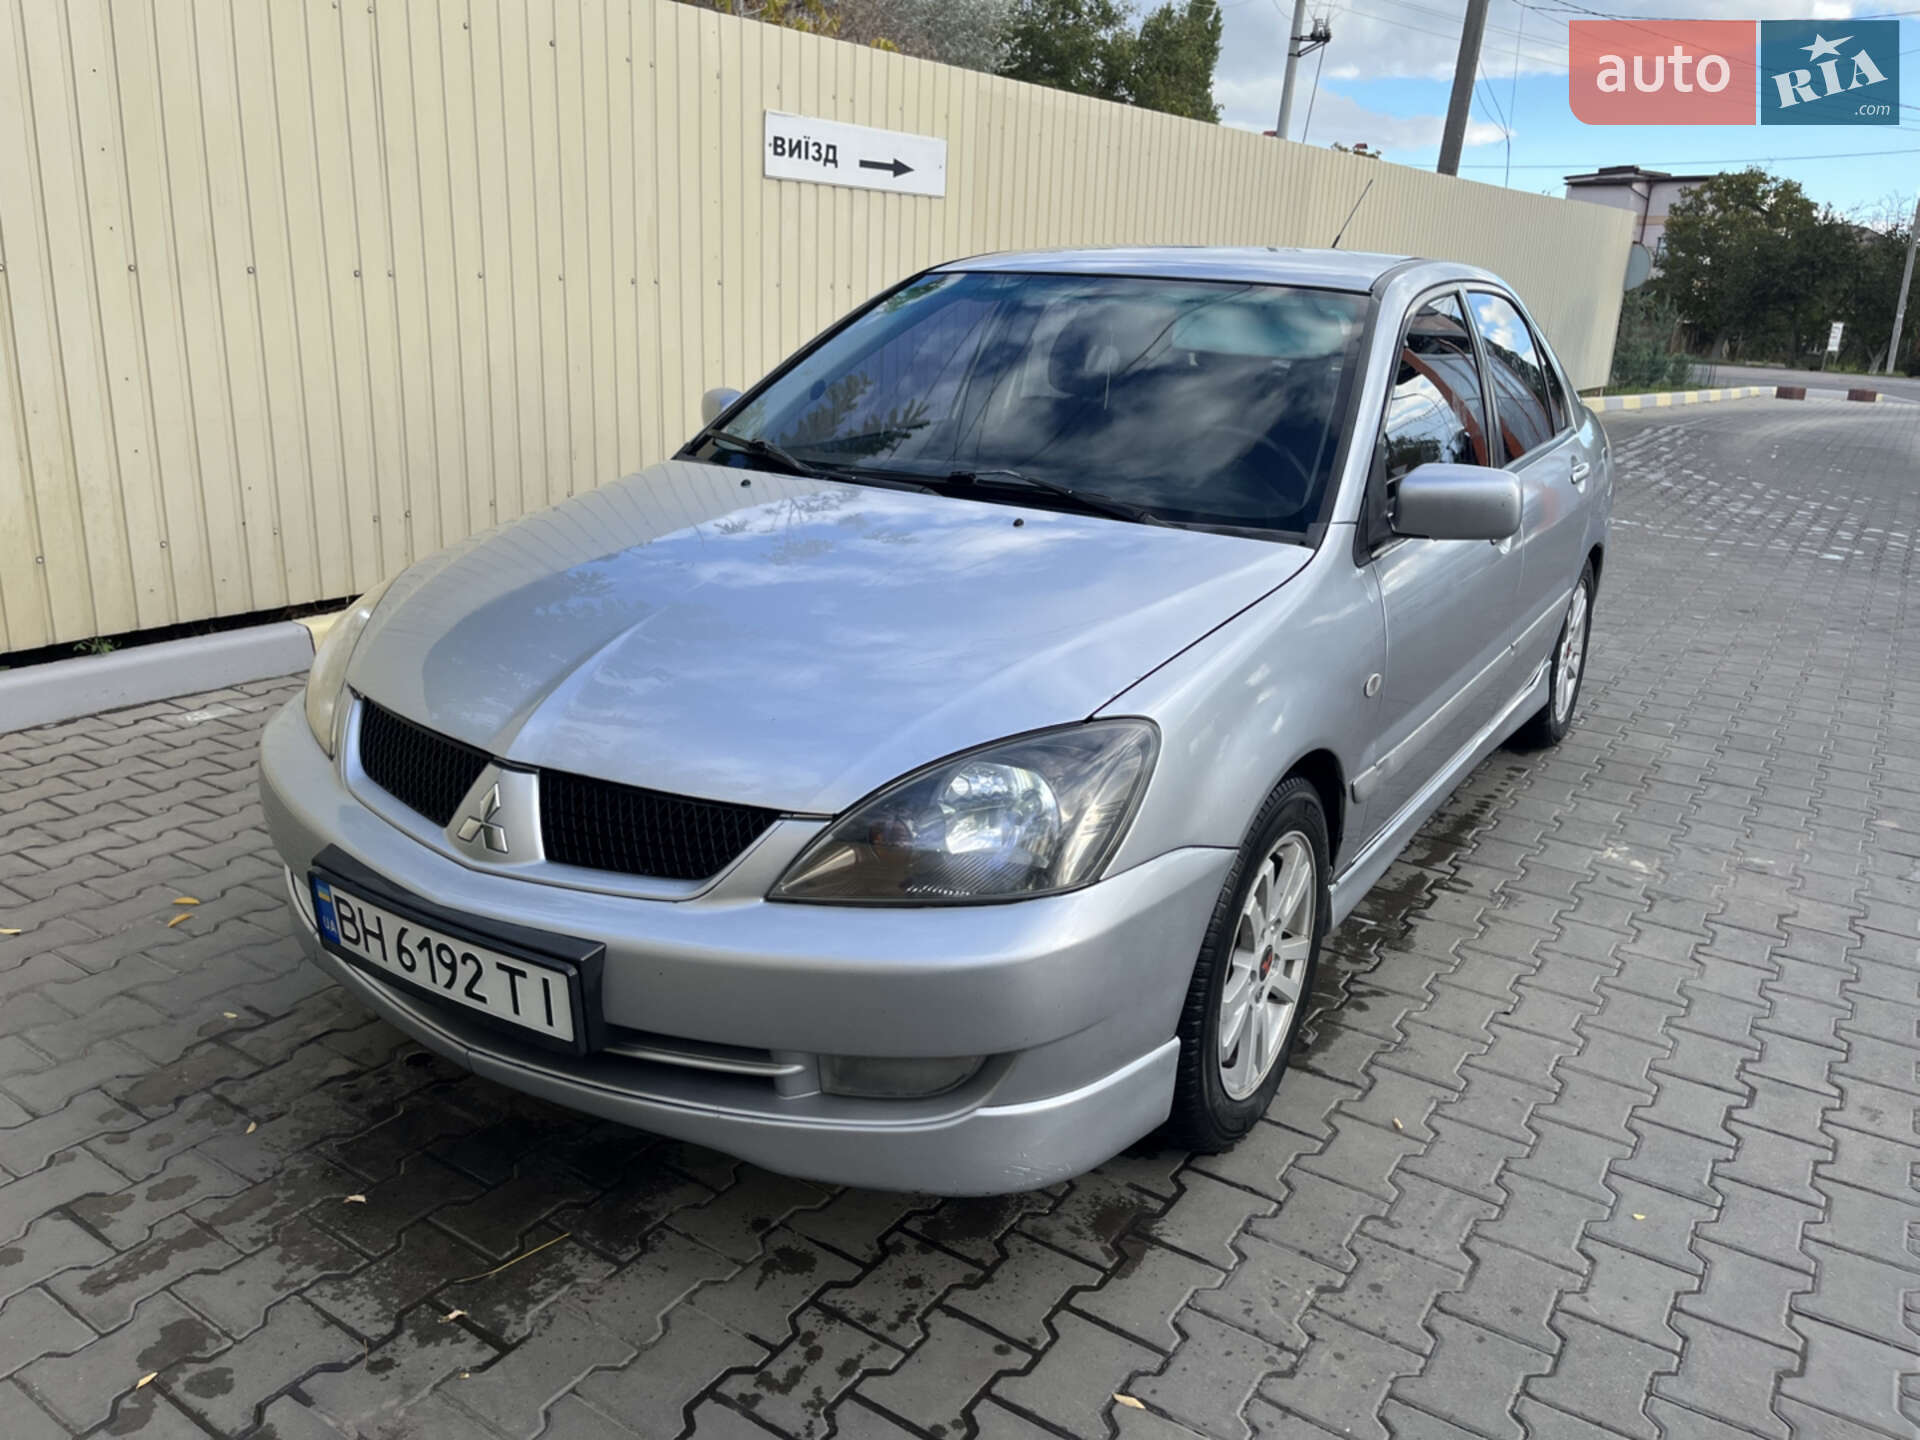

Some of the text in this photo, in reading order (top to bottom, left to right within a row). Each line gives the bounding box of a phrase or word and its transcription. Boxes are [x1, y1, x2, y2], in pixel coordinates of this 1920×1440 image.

[772, 135, 838, 169] ВИЇЗД
[322, 916, 337, 932] UA
[333, 894, 388, 962] BH
[396, 927, 488, 1005] 6192
